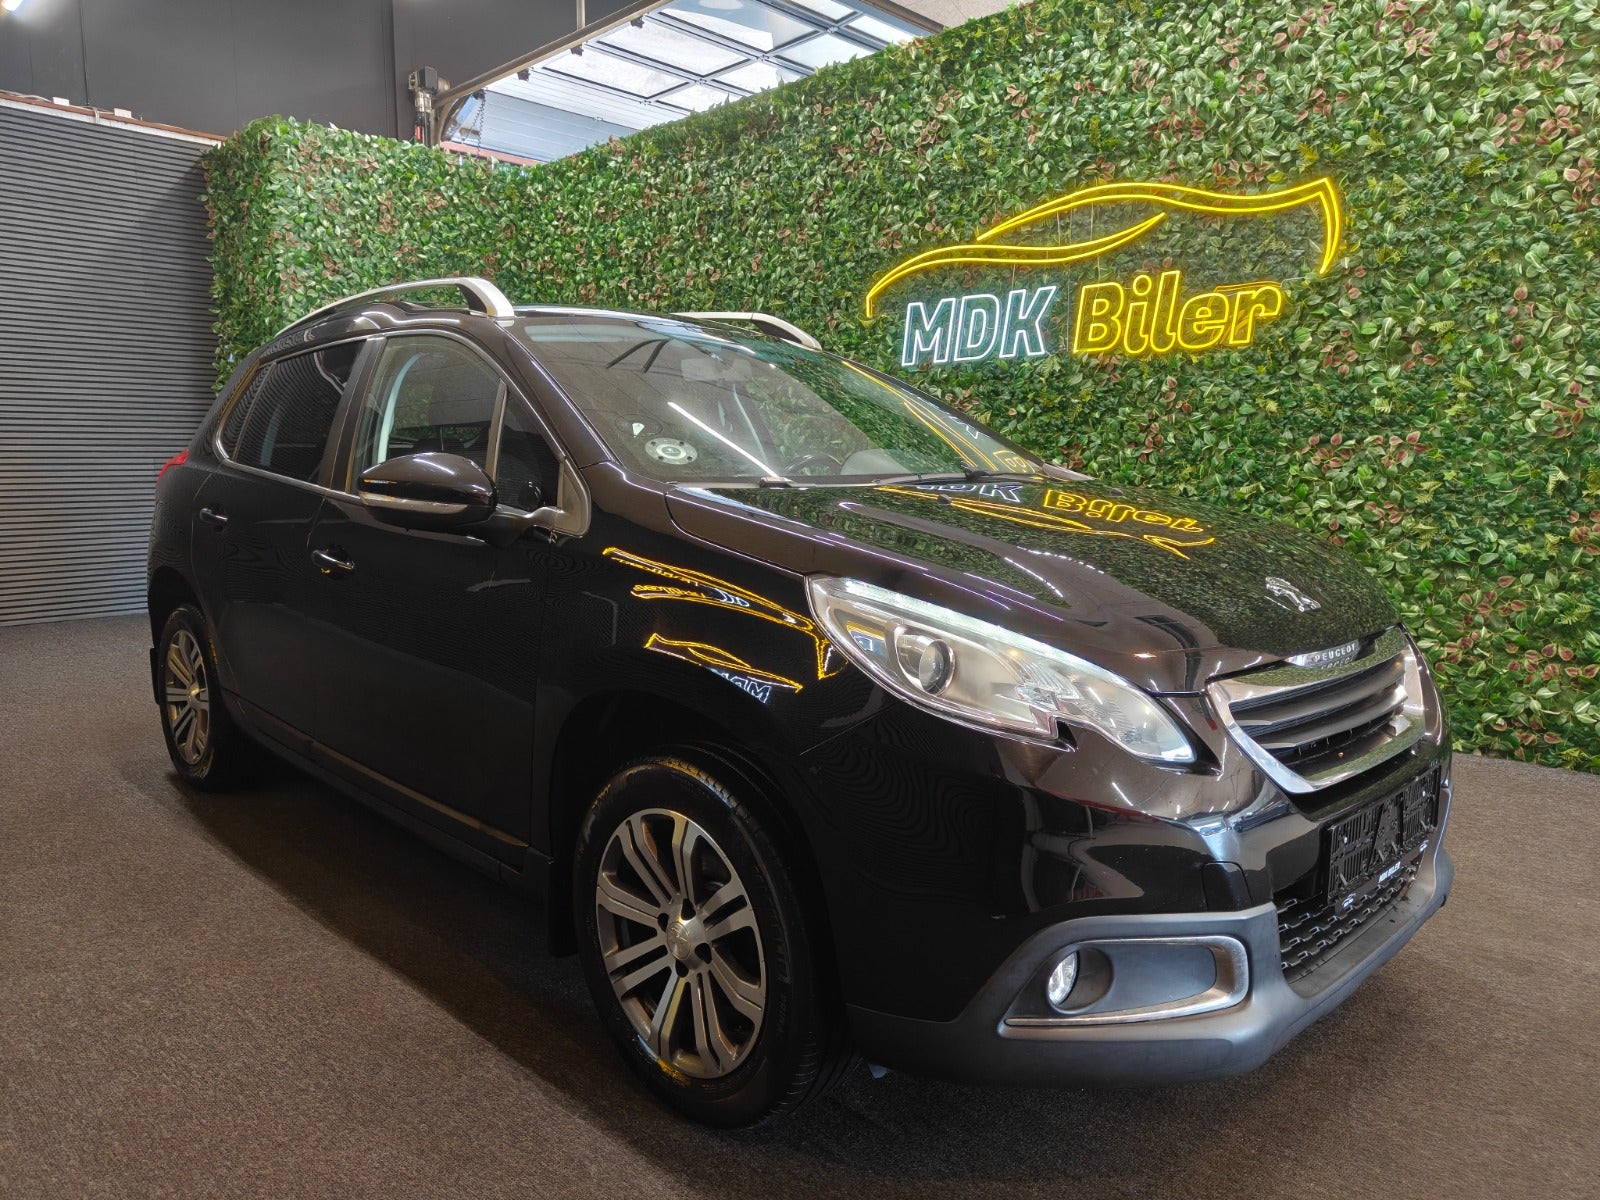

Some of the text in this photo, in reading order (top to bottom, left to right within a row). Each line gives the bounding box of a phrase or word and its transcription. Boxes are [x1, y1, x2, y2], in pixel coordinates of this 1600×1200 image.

[901, 270, 1282, 367] MDK Biler
[1314, 642, 1356, 663] PEUGEOT
